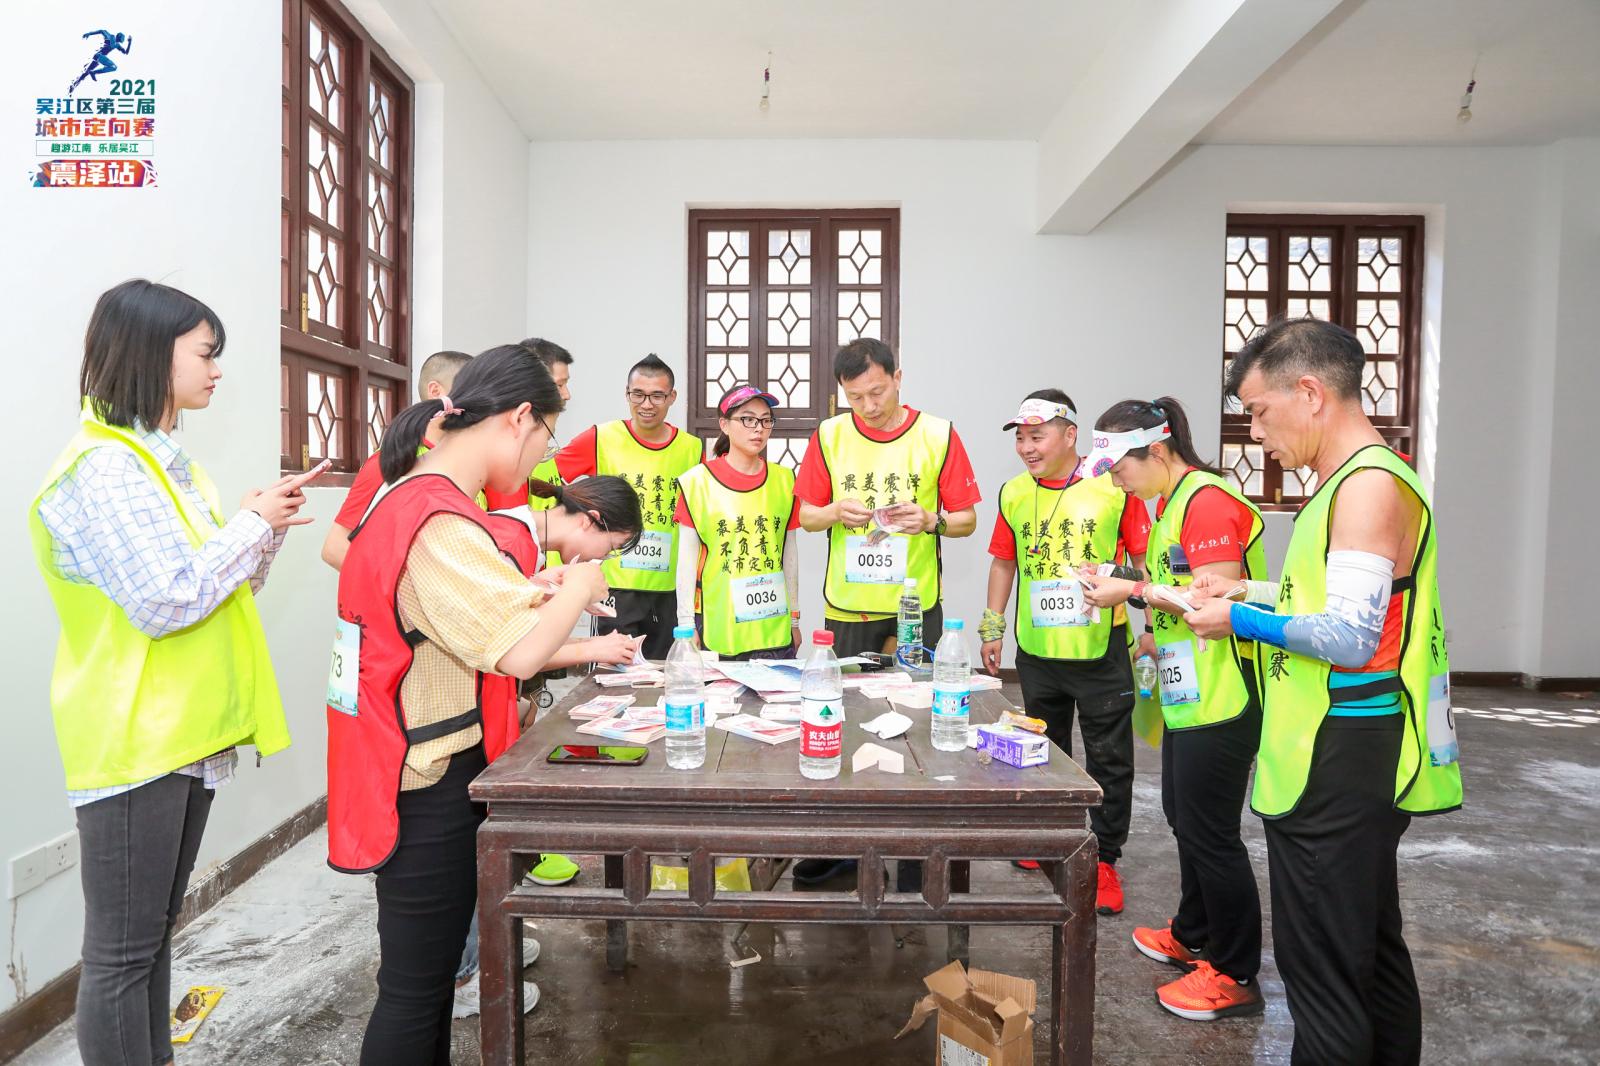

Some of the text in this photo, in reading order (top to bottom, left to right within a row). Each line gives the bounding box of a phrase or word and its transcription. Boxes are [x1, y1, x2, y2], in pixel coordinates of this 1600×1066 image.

[841, 472, 921, 492] 最美震泽
[1020, 518, 1097, 539] 最美震泽
[634, 544, 662, 557] 0034
[858, 553, 893, 567] 0035
[746, 590, 777, 606] 0036
[1040, 597, 1074, 610] 0033
